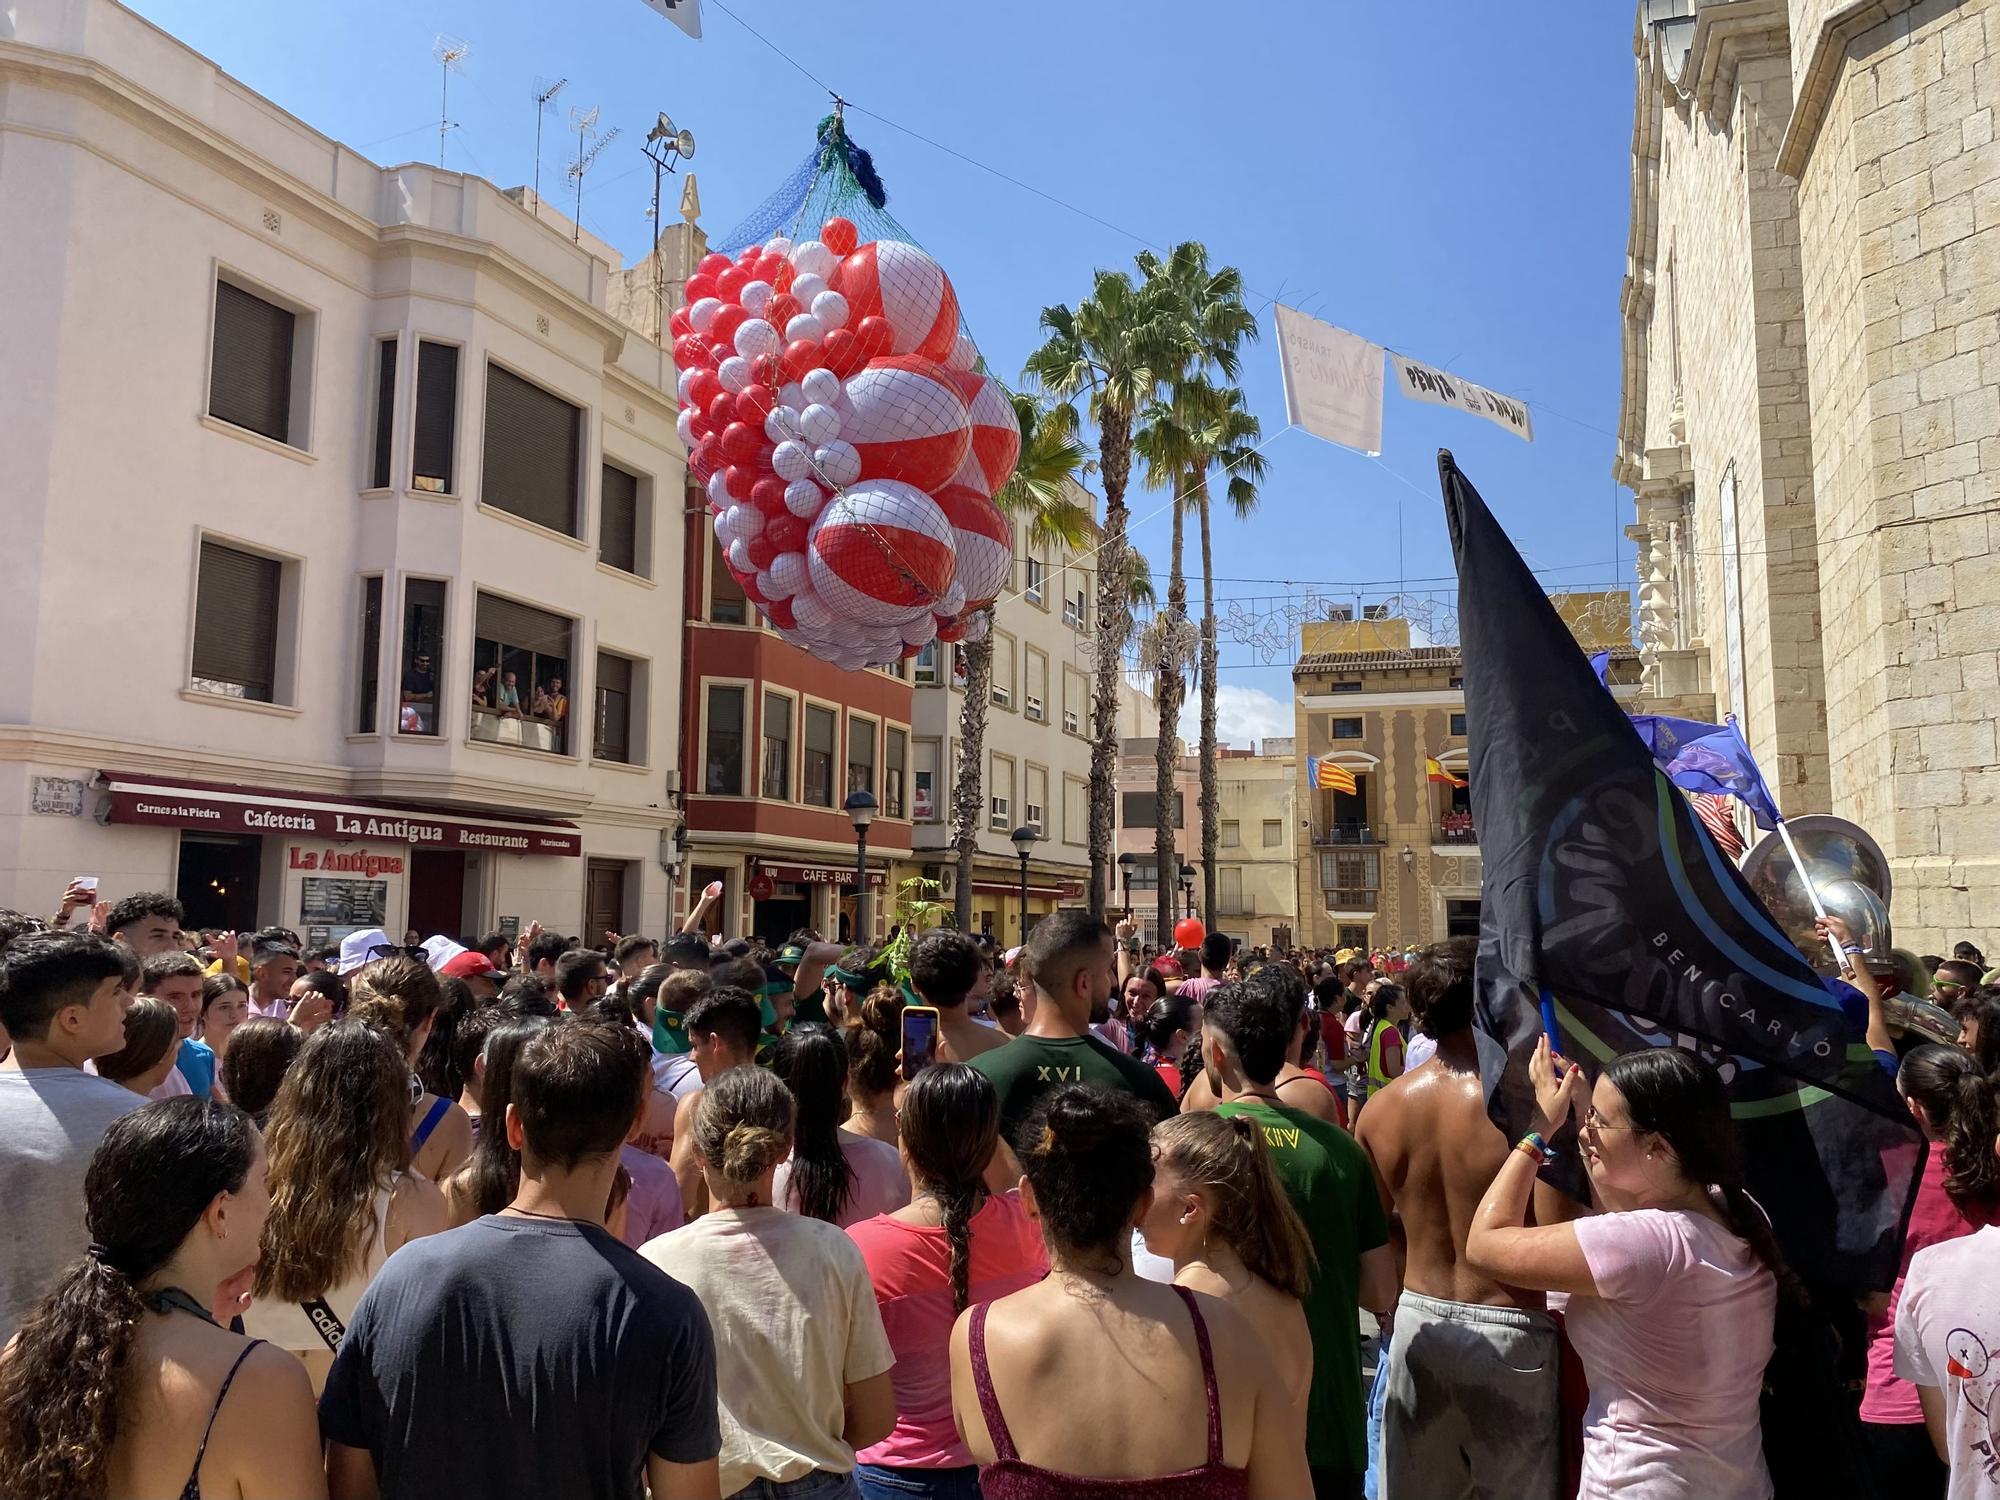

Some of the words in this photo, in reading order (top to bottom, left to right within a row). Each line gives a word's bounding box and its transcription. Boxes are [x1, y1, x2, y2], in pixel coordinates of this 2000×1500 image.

[1405, 365, 1456, 402] PENYA
[136, 803, 171, 815] Carnes
[171, 808, 178, 816] a
[178, 806, 188, 817] la
[189, 807, 221, 819] Piedra
[244, 809, 316, 831] Cafetería
[335, 815, 362, 834] La
[365, 818, 443, 843] Antigua
[459, 829, 529, 849] Restaurante
[540, 838, 571, 848] Mariscadas
[289, 847, 318, 870] La
[320, 848, 404, 878] Antigua
[802, 869, 828, 882] CAFE
[835, 872, 852, 884] BAR
[1652, 931, 1831, 1057] BENICARLÓ
[1037, 1065, 1081, 1082] XVI
